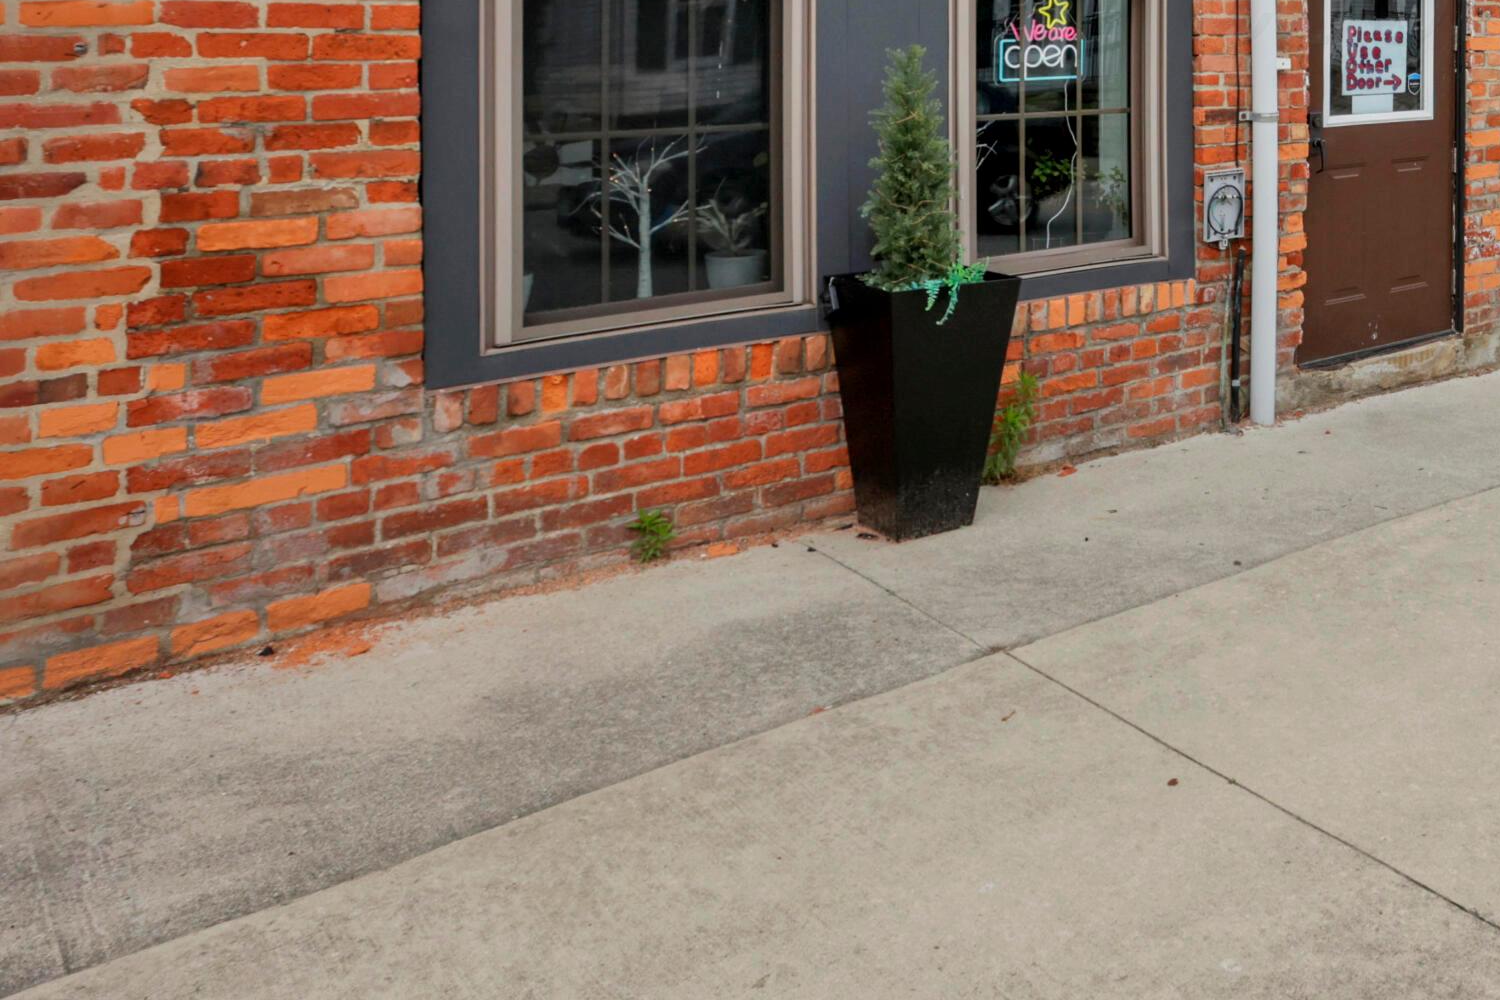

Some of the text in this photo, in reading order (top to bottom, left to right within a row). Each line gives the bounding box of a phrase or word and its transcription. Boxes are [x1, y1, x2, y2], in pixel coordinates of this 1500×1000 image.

[1048, 25, 1078, 41] are
[1347, 25, 1404, 44] Please
[1347, 42, 1381, 59] Use
[1346, 58, 1392, 74] Other
[1346, 73, 1382, 91] Door
